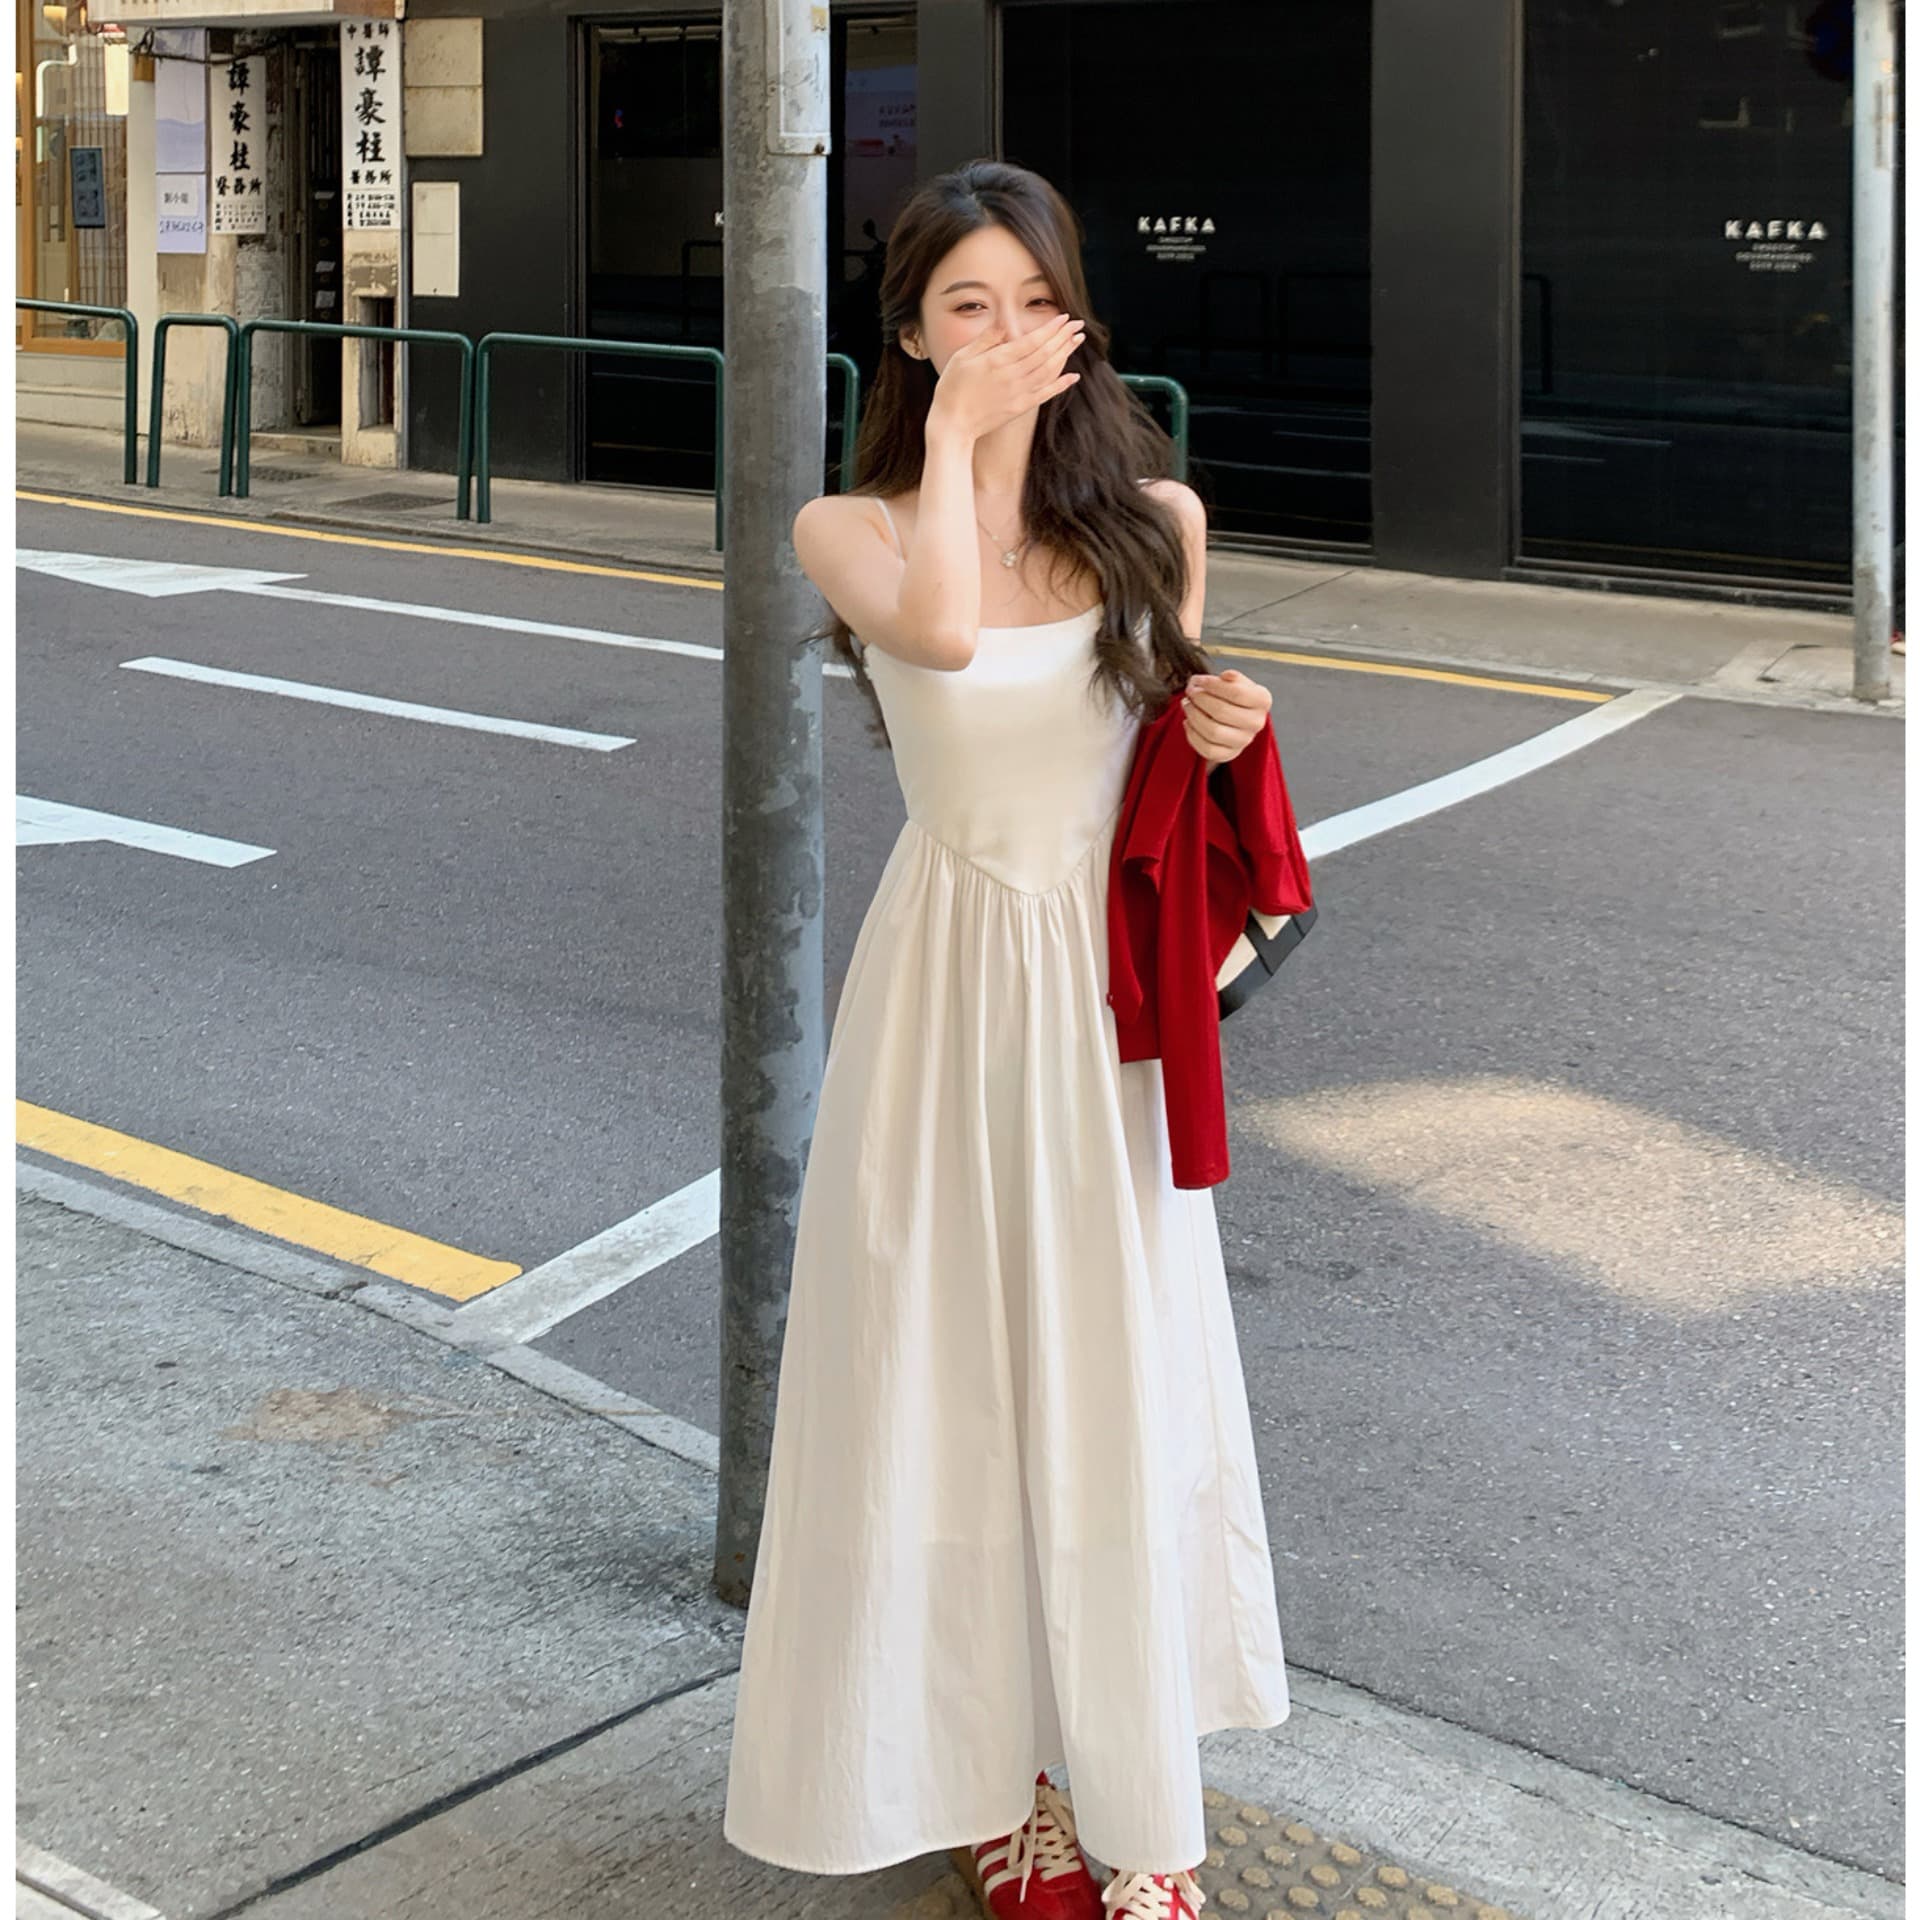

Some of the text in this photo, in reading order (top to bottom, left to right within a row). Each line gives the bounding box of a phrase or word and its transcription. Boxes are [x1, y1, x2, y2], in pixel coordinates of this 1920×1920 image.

[226, 61, 250, 170] 譚豪柱
[355, 45, 387, 163] 譚豪柱
[1137, 216, 1216, 232] KAFKA
[1724, 220, 1828, 240] KAFKA
